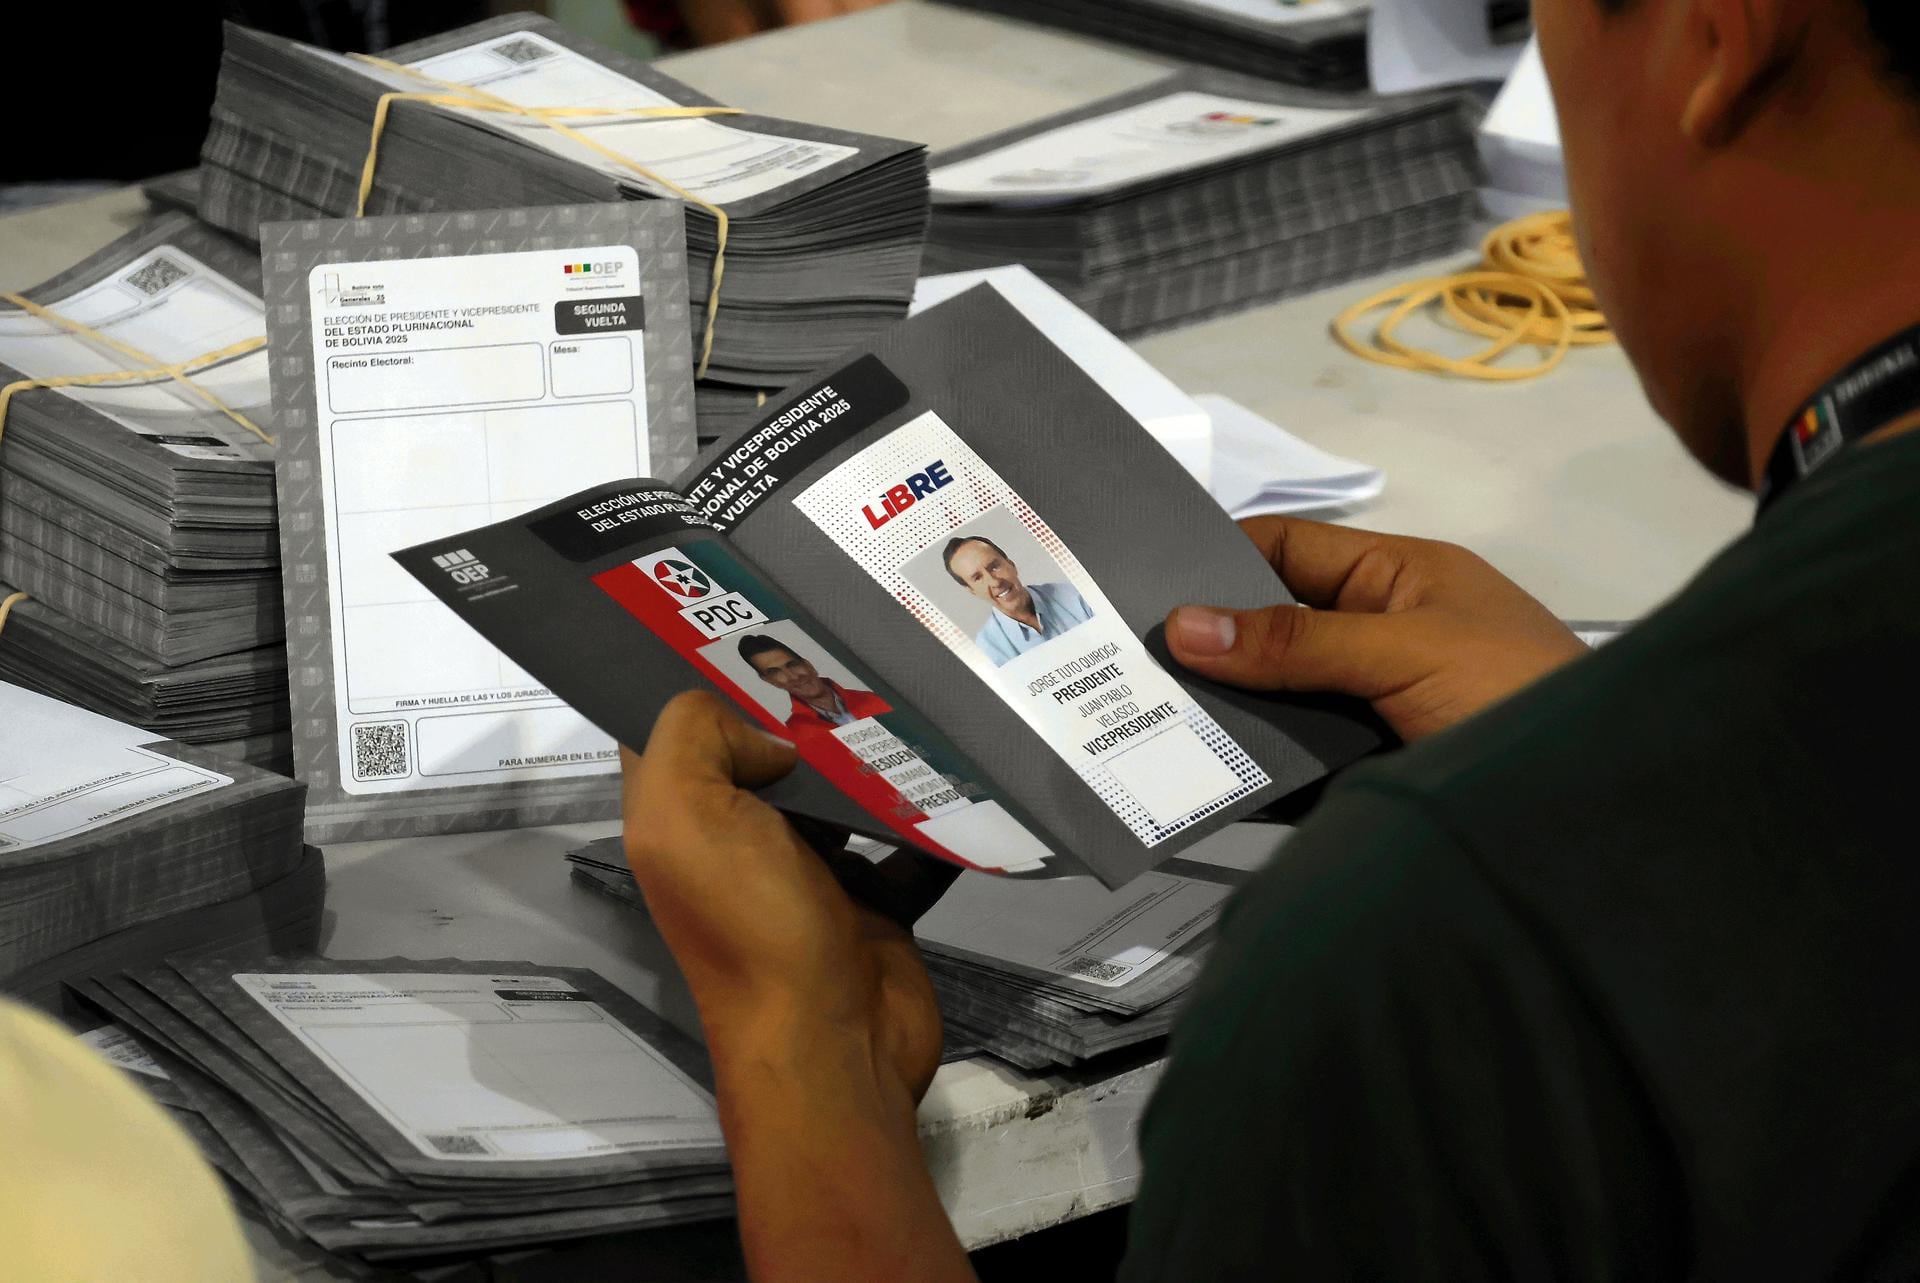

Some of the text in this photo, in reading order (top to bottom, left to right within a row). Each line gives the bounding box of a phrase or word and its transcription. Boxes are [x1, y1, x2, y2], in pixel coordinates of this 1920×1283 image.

[592, 261, 624, 275] OEP
[323, 303, 540, 326] ELECCIÓN DE PRESIDENTE Y VICEPRESIDENTE
[573, 302, 626, 315] SEGUNDA
[324, 319, 475, 337] DEL ESTADO PLURINACIONAL
[584, 315, 627, 328] VUELTA
[325, 334, 408, 348] DE BOLIVIA 2025
[332, 356, 414, 369] Recinto Electoral:
[577, 493, 640, 521] ELECCIÓN
[636, 491, 657, 502] DE
[711, 466, 725, 480] Y
[722, 385, 838, 469] VICEPRESIDENTE
[591, 517, 621, 533] DEL
[617, 504, 666, 523] ESTADO
[743, 456, 769, 478] DE
[763, 419, 822, 461] BOLIVIA
[818, 398, 851, 424] 2025
[721, 474, 779, 522] VUELTA
[450, 563, 489, 584] OEP
[692, 599, 753, 632] PDC
[1027, 641, 1123, 697] JORGE TUTO QUIROGA
[1052, 662, 1124, 705] PRESIDENTE
[395, 699, 420, 708] FIRMA
[421, 698, 427, 706] Y
[428, 696, 459, 706] HUELLA
[460, 694, 471, 702] DE
[473, 693, 488, 701] LAS
[489, 692, 494, 700] Y
[496, 691, 512, 700] LOS
[1077, 683, 1133, 718] JUAN PABLO
[1095, 701, 1140, 729] VELASCO
[1082, 701, 1178, 756] VICEPRESIDENTE
[498, 758, 523, 767] PARA
[525, 753, 568, 765] NUMERAR
[570, 752, 582, 761] EN
[583, 751, 594, 760] EL
